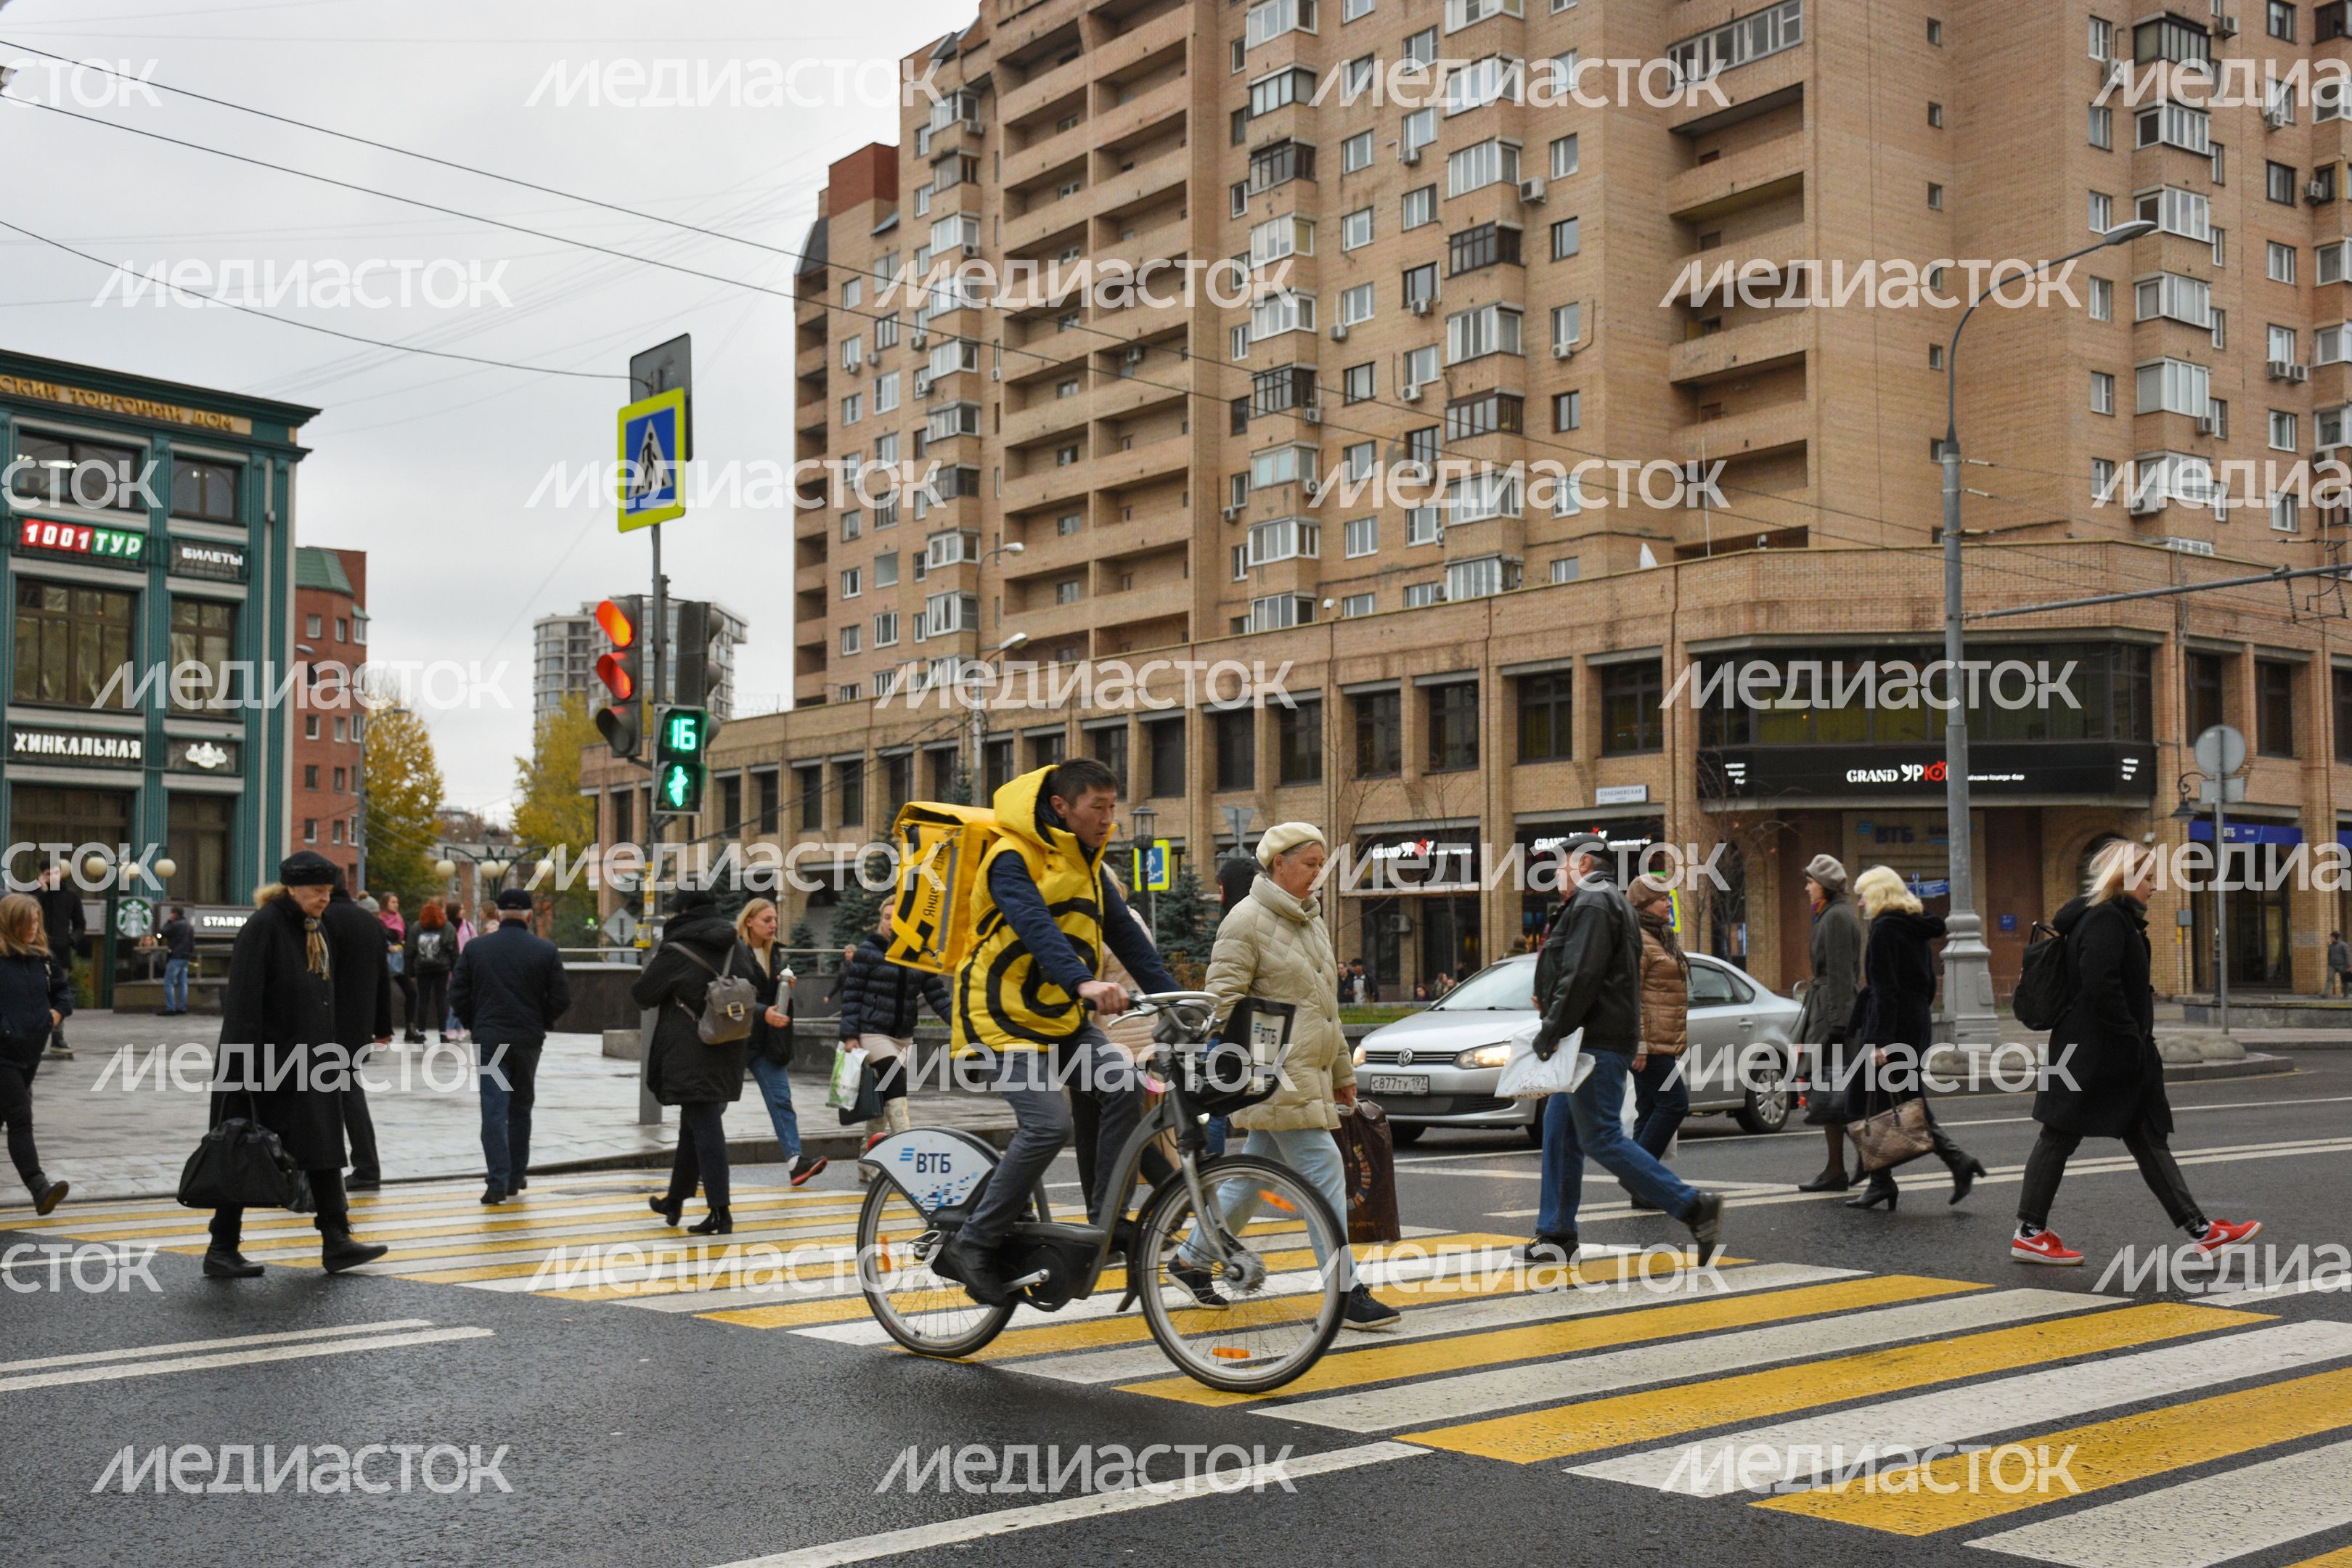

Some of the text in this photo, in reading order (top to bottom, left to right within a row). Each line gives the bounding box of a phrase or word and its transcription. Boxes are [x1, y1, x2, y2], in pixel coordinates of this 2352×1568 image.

[190, 409, 233, 430] ДОМ
[181, 547, 243, 566] БИЛЕТЫ
[672, 719, 696, 750] 16
[13, 732, 142, 759] ХИНКАЛЬНАЯ
[1846, 769, 1898, 782] GRAND
[1900, 761, 1948, 782] УРЮ
[1875, 826, 1915, 844] ВТБ
[2224, 828, 2236, 838] ВТБ
[916, 1153, 952, 1174] ВТБ
